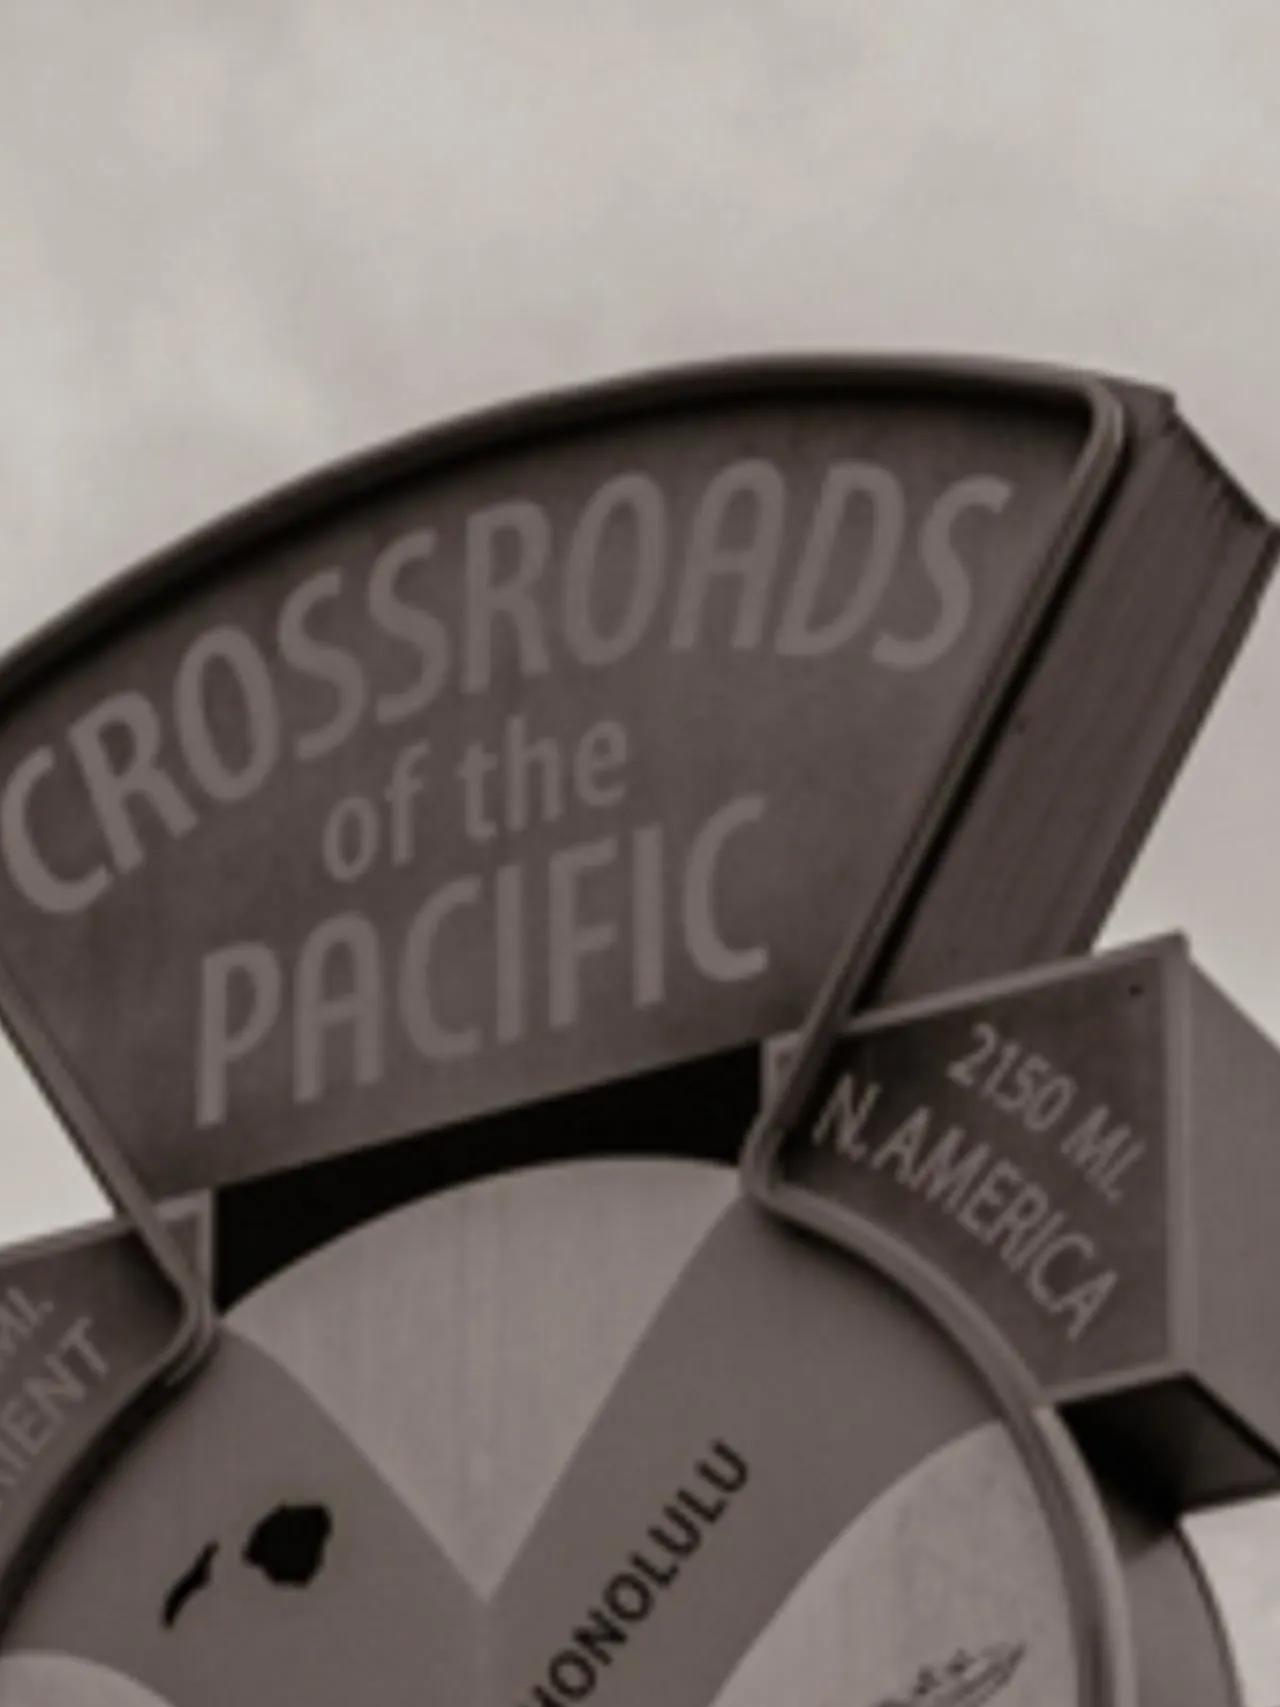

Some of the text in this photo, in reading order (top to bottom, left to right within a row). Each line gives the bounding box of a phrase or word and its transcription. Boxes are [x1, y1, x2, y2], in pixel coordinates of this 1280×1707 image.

[322, 718, 629, 884] of the
[195, 798, 768, 1128] PACIFIC
[946, 1021, 1078, 1132] 2150
